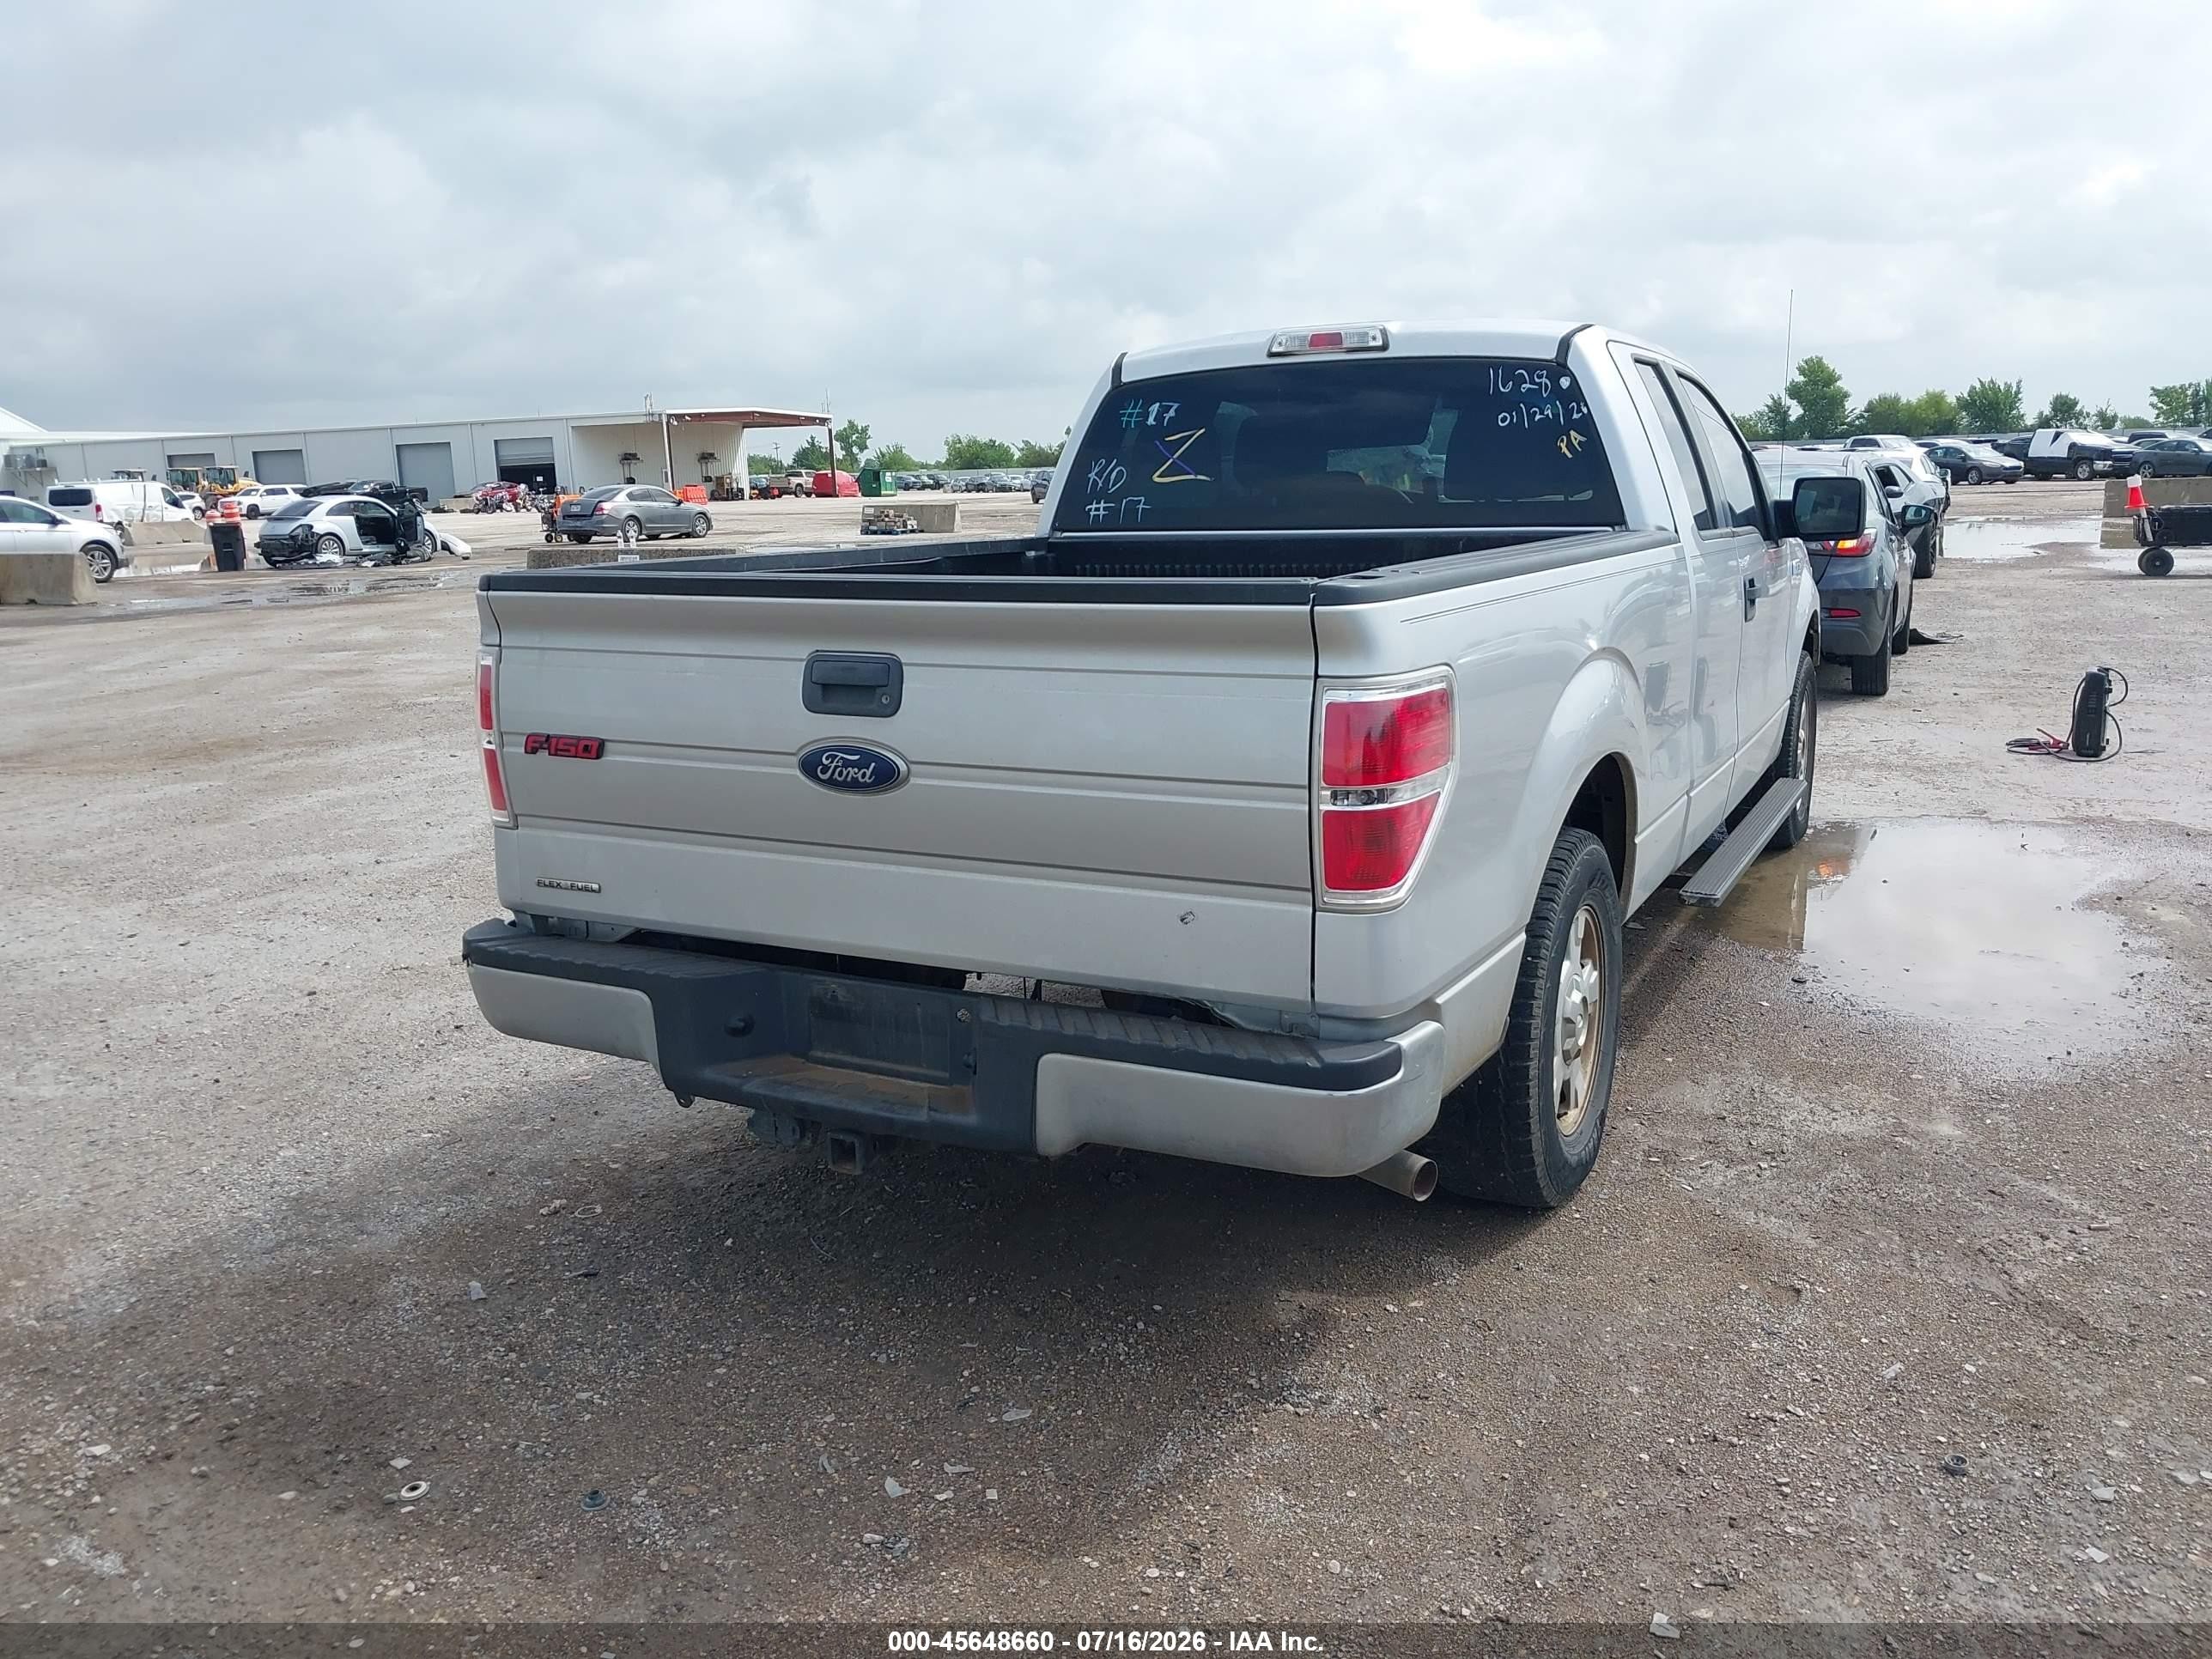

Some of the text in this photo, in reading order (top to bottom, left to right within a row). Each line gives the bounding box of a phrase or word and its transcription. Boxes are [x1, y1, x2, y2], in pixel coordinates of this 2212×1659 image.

[1085, 495, 1153, 526] #17
[525, 733, 604, 760] F-150
[817, 751, 876, 783] Ford
[537, 878, 597, 893] FLEX FUEL
